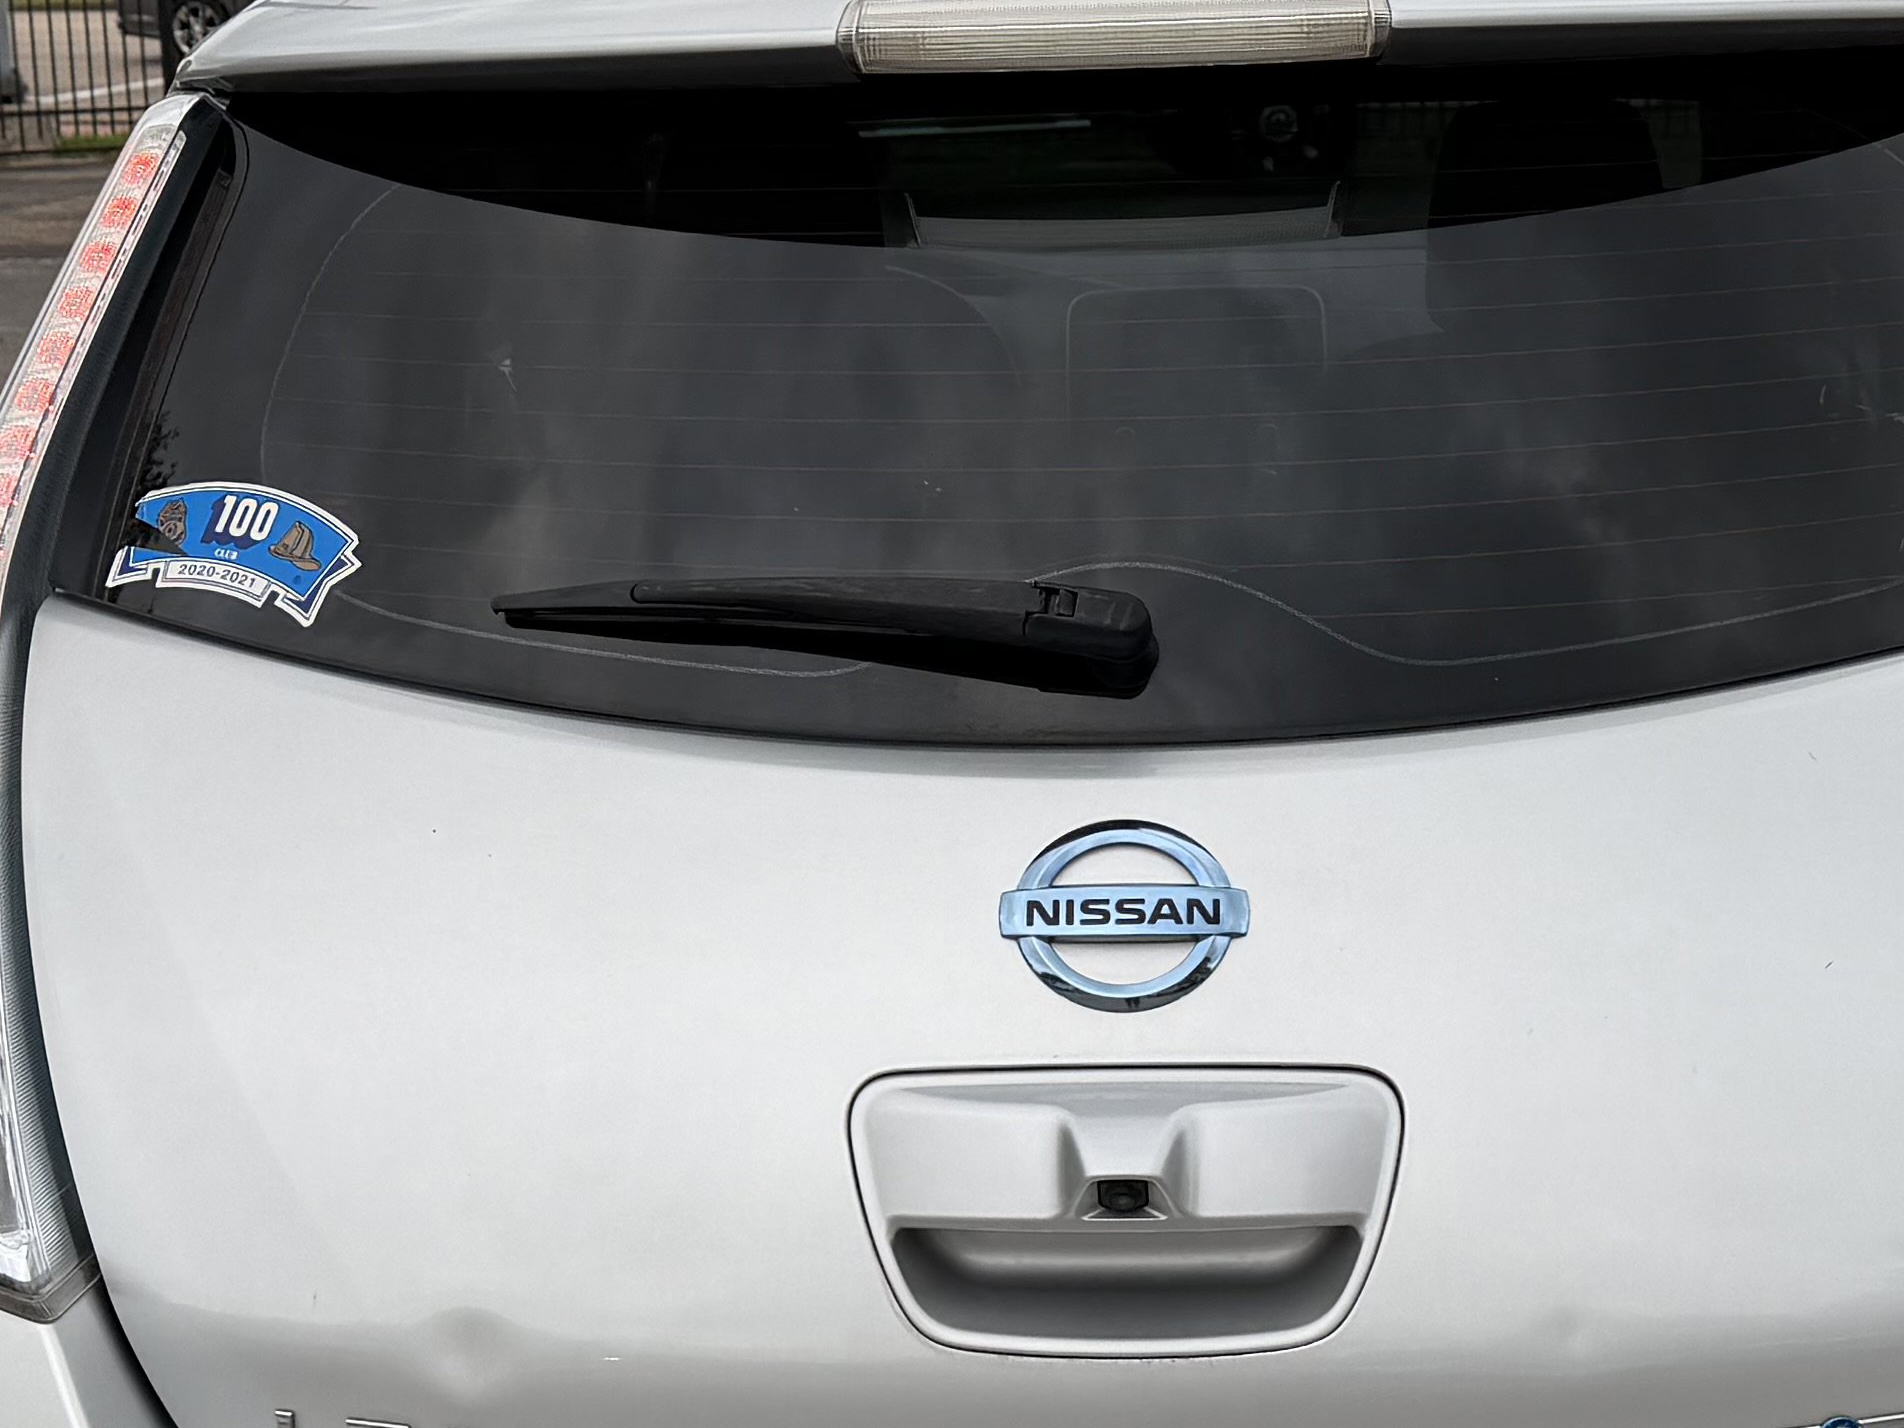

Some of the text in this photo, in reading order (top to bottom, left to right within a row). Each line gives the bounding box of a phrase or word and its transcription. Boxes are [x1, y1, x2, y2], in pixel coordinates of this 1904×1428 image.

[214, 494, 279, 541] 100
[178, 563, 257, 589] 2020-2021
[1026, 897, 1221, 927] NISSAN
